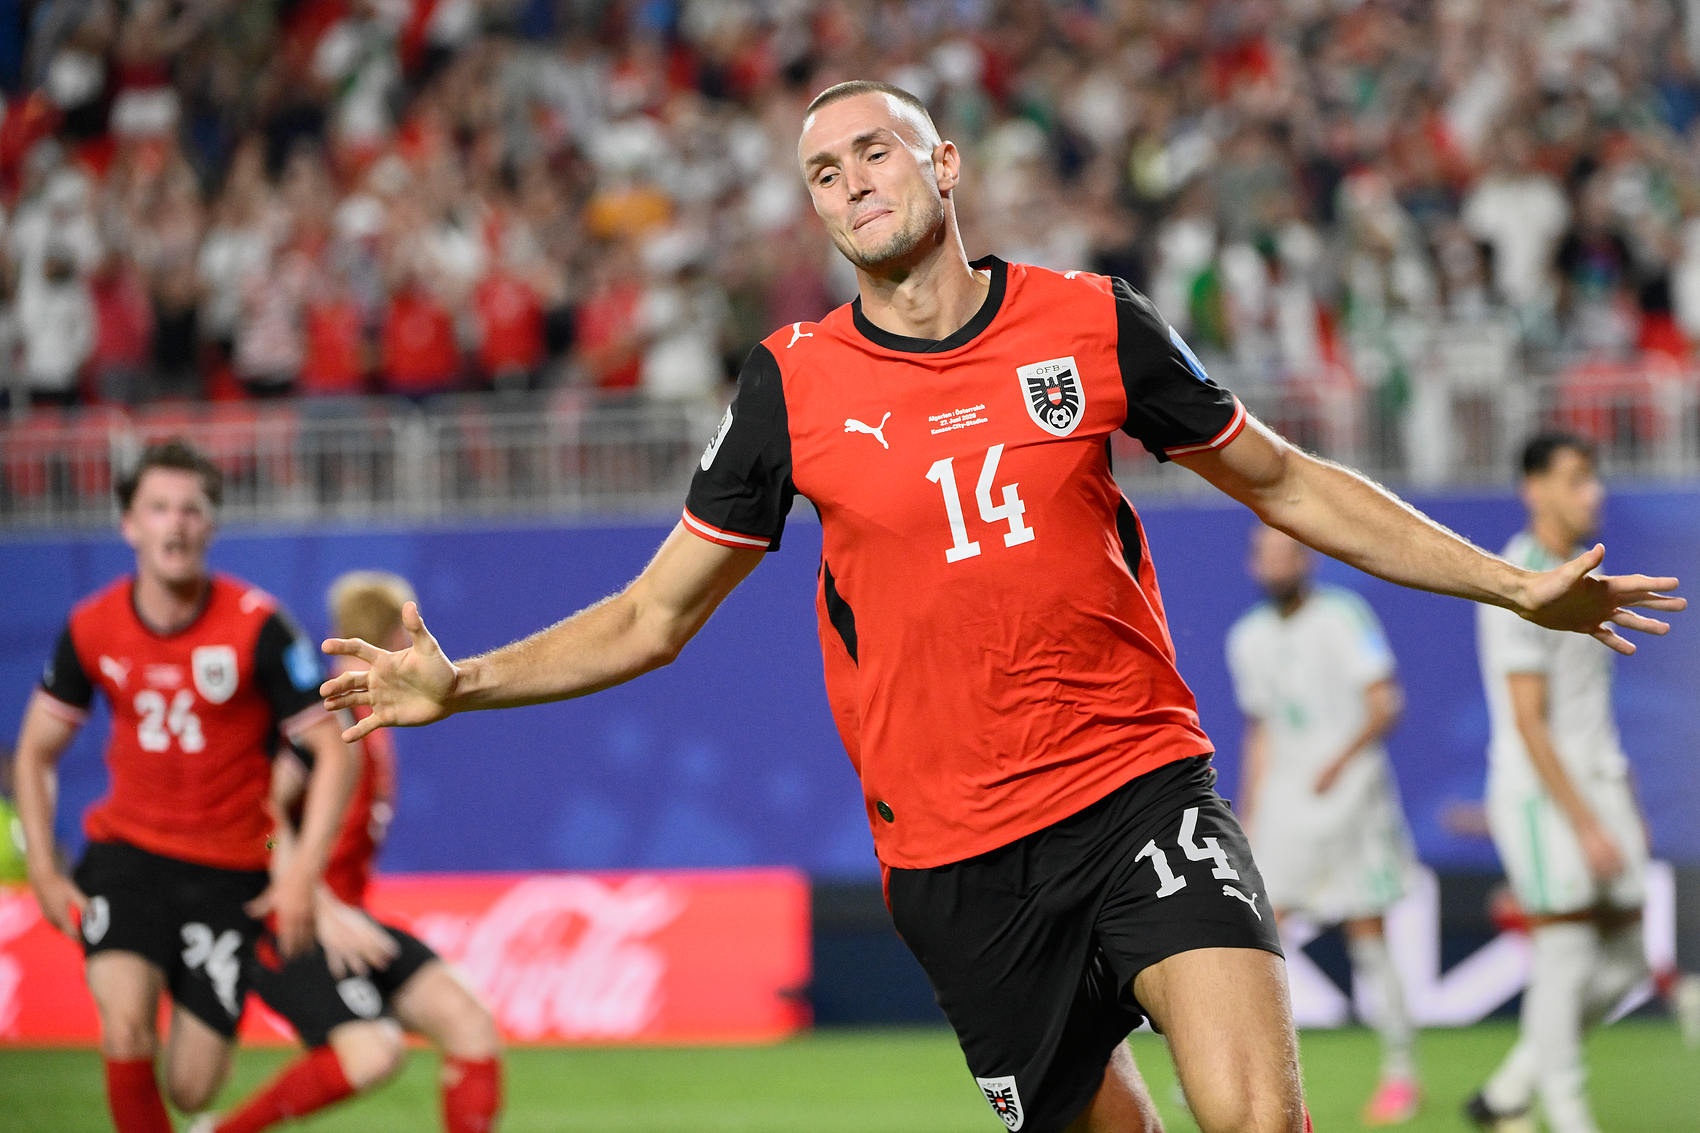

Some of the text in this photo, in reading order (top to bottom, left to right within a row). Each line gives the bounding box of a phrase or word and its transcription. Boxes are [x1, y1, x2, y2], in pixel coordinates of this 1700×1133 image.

[925, 443, 1035, 563] 14
[134, 688, 207, 753] 24
[1134, 806, 1240, 898] 14
